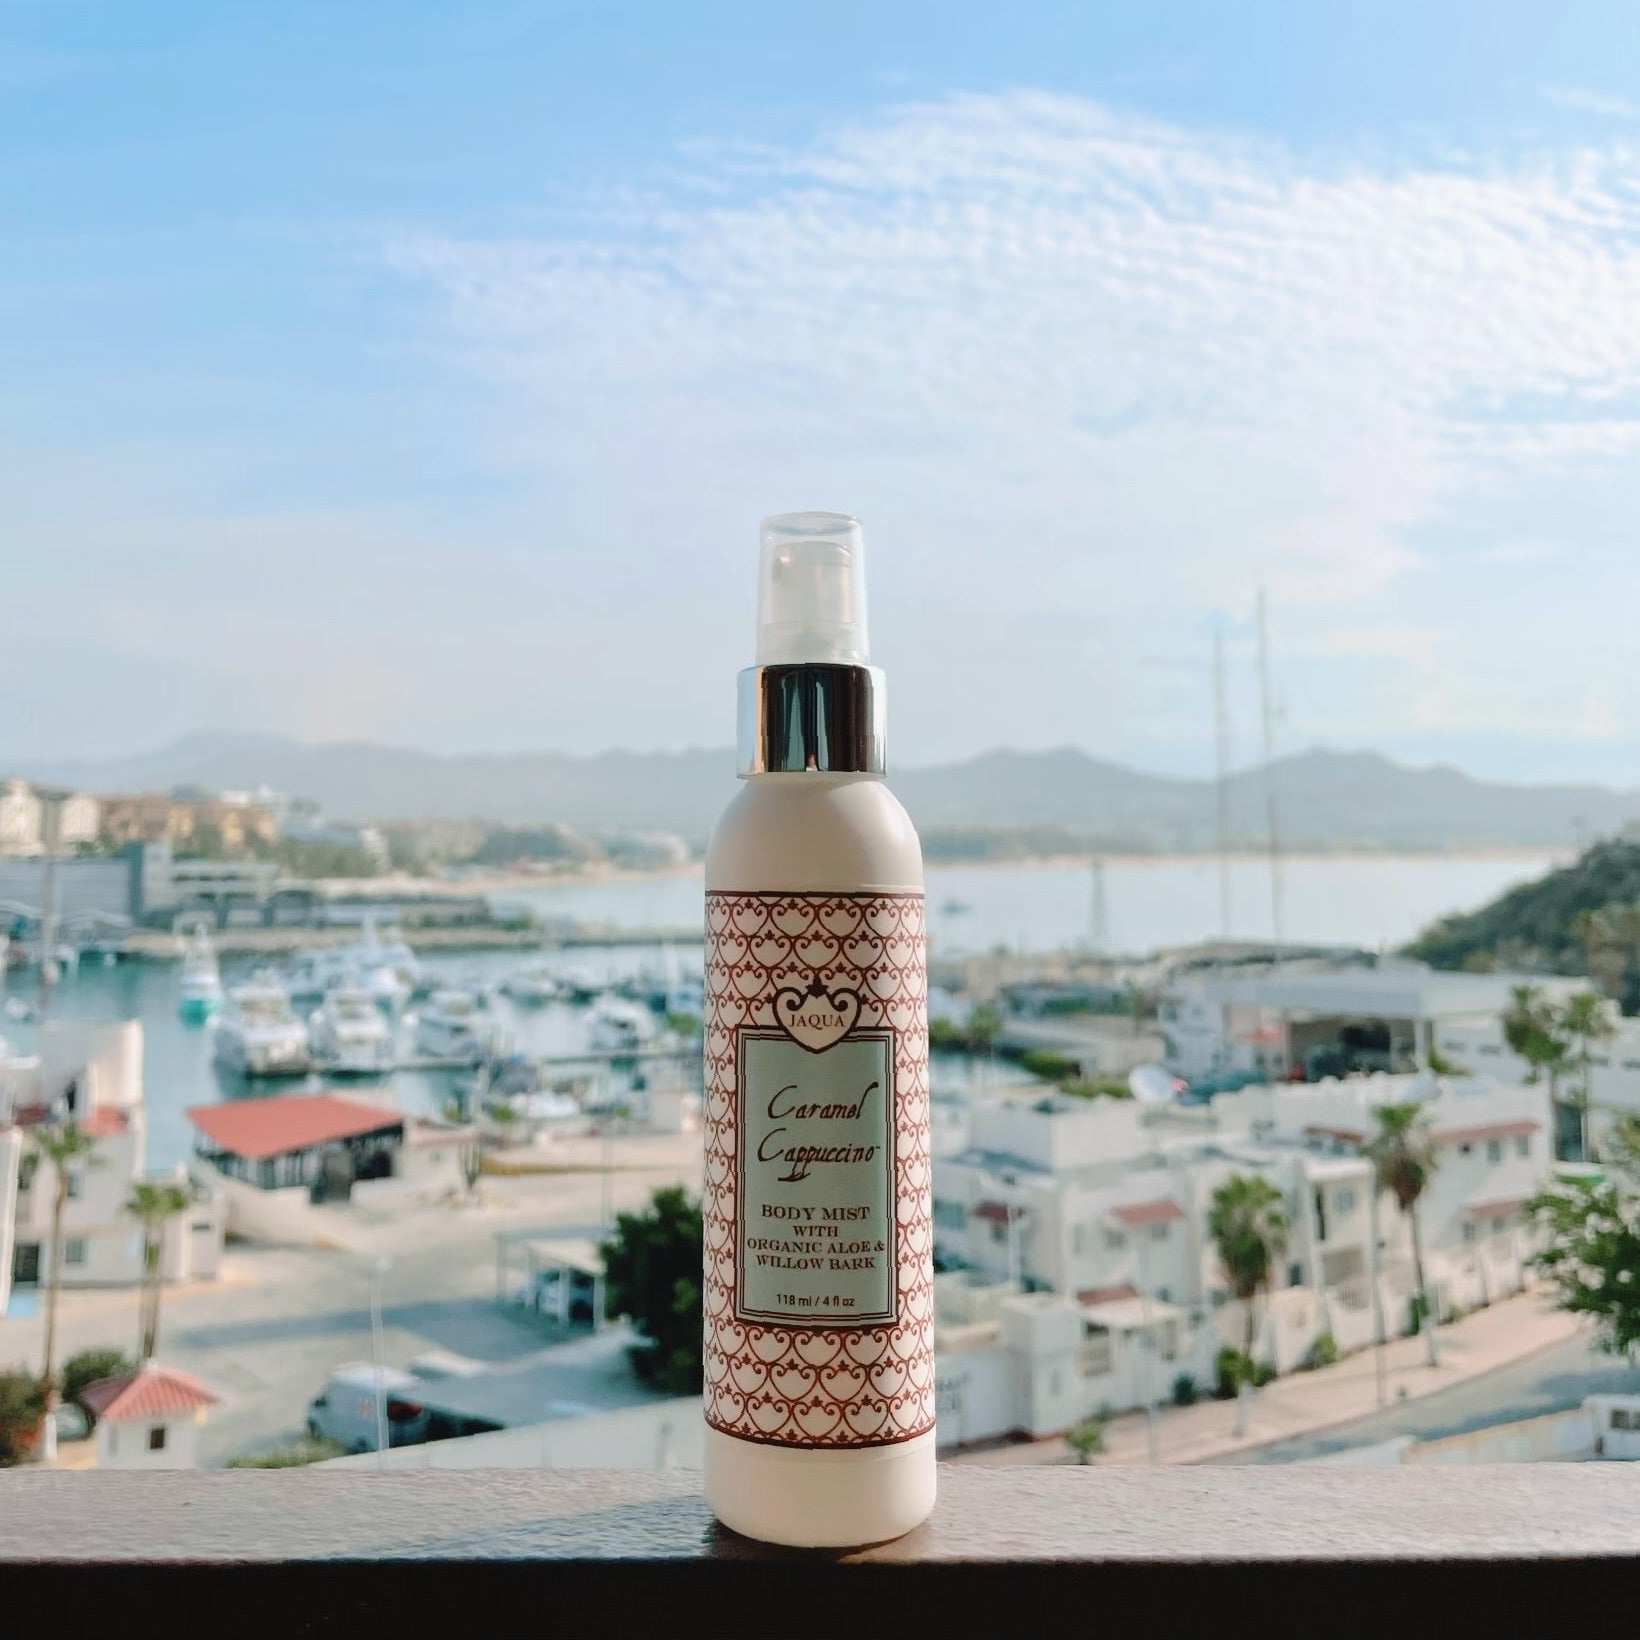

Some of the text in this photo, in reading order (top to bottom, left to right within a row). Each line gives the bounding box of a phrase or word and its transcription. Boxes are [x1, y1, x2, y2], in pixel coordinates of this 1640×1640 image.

[788, 1013, 846, 1030] JAQUA
[768, 1081, 880, 1119] Caramel
[757, 1128, 880, 1182] Cappuccino
[762, 1204, 871, 1221] BODY MIST
[793, 1225, 838, 1237] WITH
[747, 1238, 886, 1254] ORGANIC ALOE &
[756, 1254, 876, 1270] WILLOW BARK
[776, 1293, 796, 1306] 118
[798, 1295, 812, 1307] ml
[823, 1296, 830, 1306] 4
[833, 1295, 839, 1307] fl
[842, 1297, 855, 1307] oz
